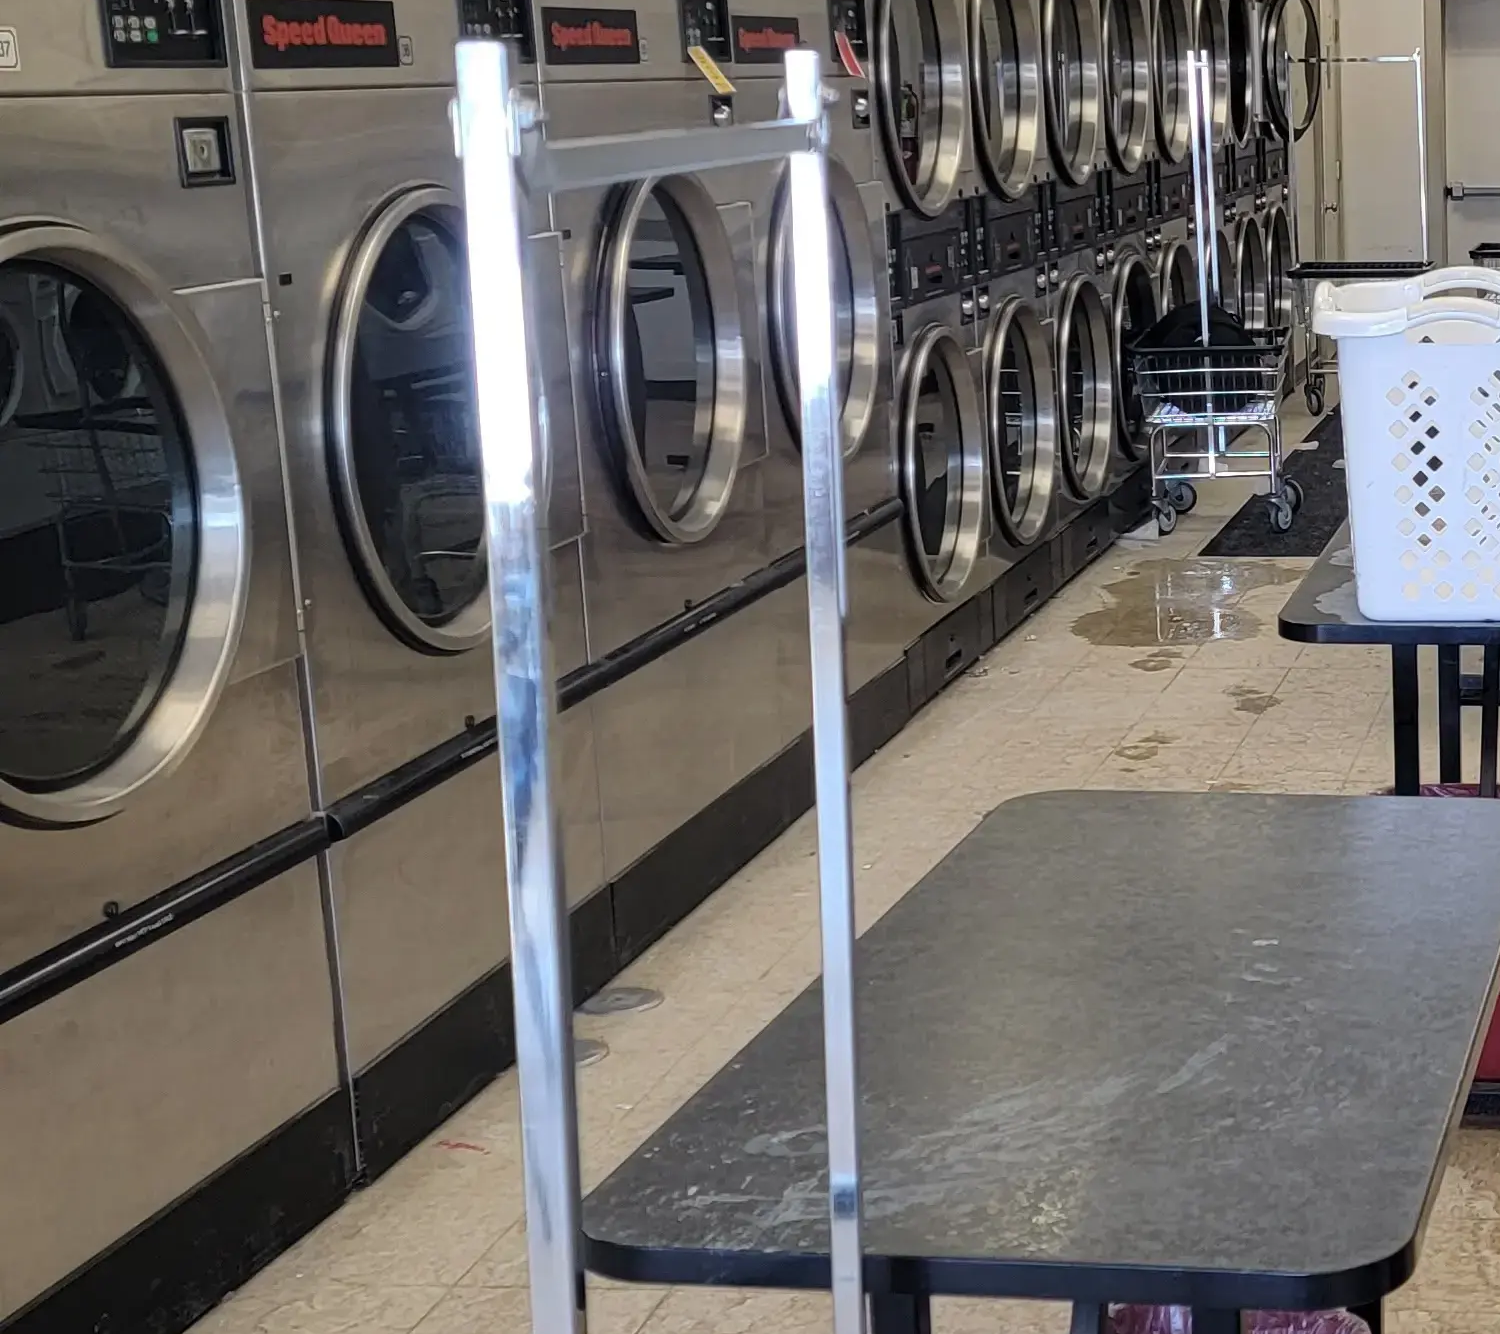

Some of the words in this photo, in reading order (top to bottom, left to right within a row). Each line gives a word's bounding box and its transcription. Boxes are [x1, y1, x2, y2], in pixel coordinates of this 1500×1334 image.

[262, 14, 326, 51] Speed
[326, 14, 387, 46] Queen
[551, 21, 592, 51] Speed
